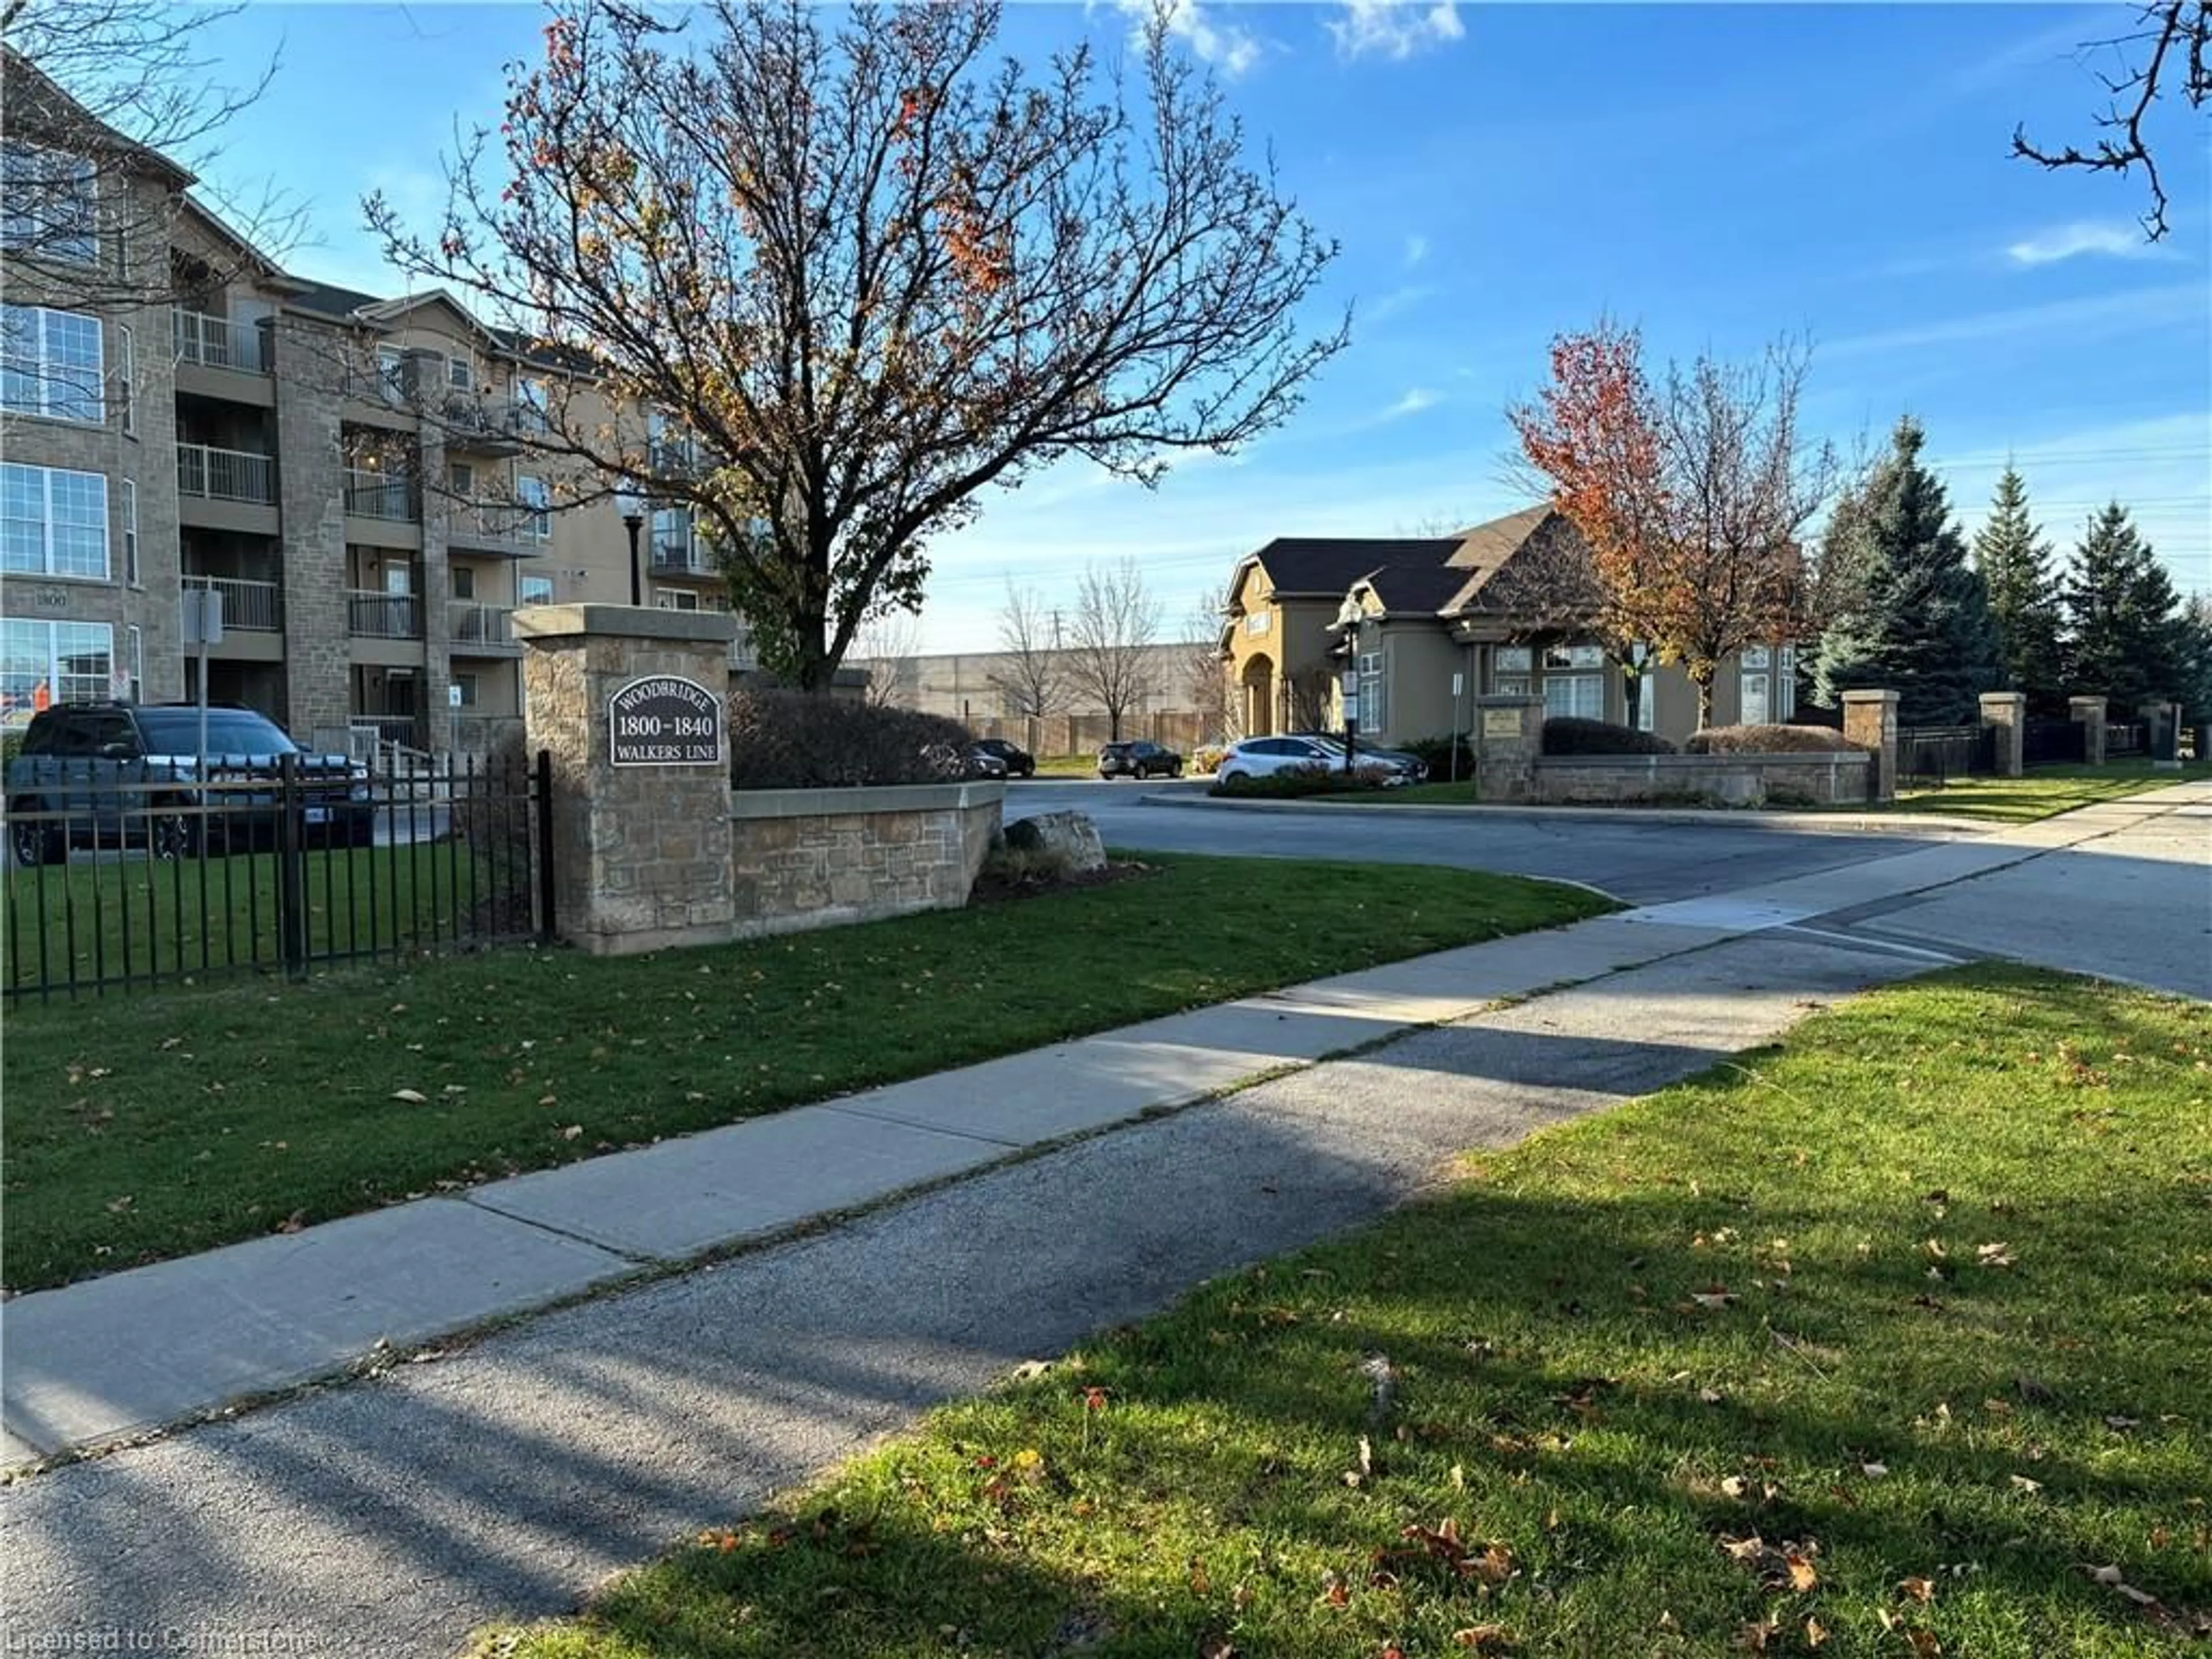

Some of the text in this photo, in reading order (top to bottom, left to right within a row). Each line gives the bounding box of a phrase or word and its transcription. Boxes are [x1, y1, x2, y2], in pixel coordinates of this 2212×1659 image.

[618, 681, 711, 712] WOODBRIDGE
[618, 745, 715, 759] WALKERS LINE
